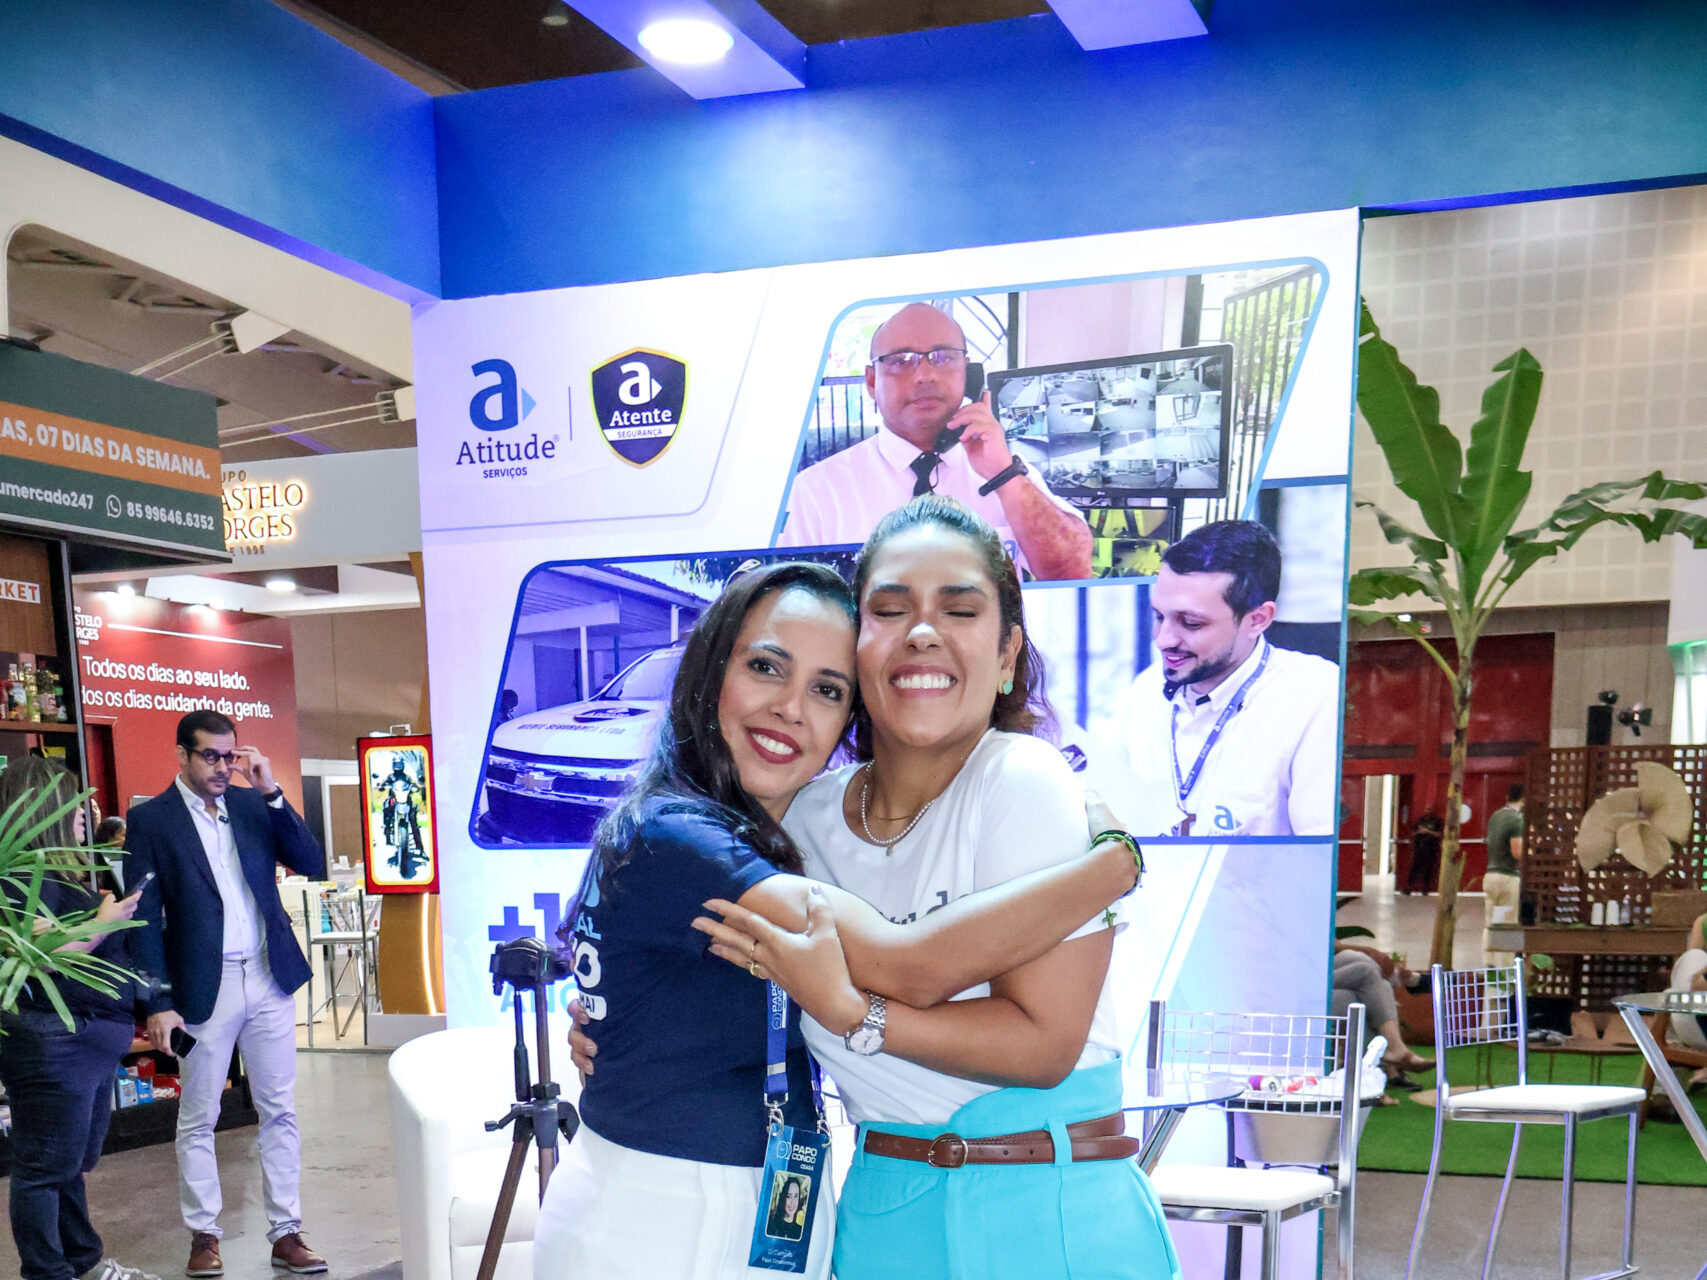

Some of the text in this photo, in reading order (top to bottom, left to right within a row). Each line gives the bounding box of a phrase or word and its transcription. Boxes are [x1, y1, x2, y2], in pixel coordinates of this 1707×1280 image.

[609, 407, 673, 427] Atente
[616, 427, 663, 440] SEGURANÇA
[0, 416, 211, 480] AS, 07 DIAS DA SEMANA.
[483, 466, 528, 480] SERVIÇOS
[126, 501, 143, 519] 85
[0, 580, 38, 601] KET
[82, 655, 250, 691] Todos os dias ao seu lado.
[105, 691, 122, 708] os
[124, 689, 153, 710] dias
[154, 692, 215, 713] cuidando
[217, 697, 233, 715] da
[234, 701, 273, 721] gente.
[791, 1153, 817, 1164] CONDO
[793, 1144, 818, 1157] PAPO
